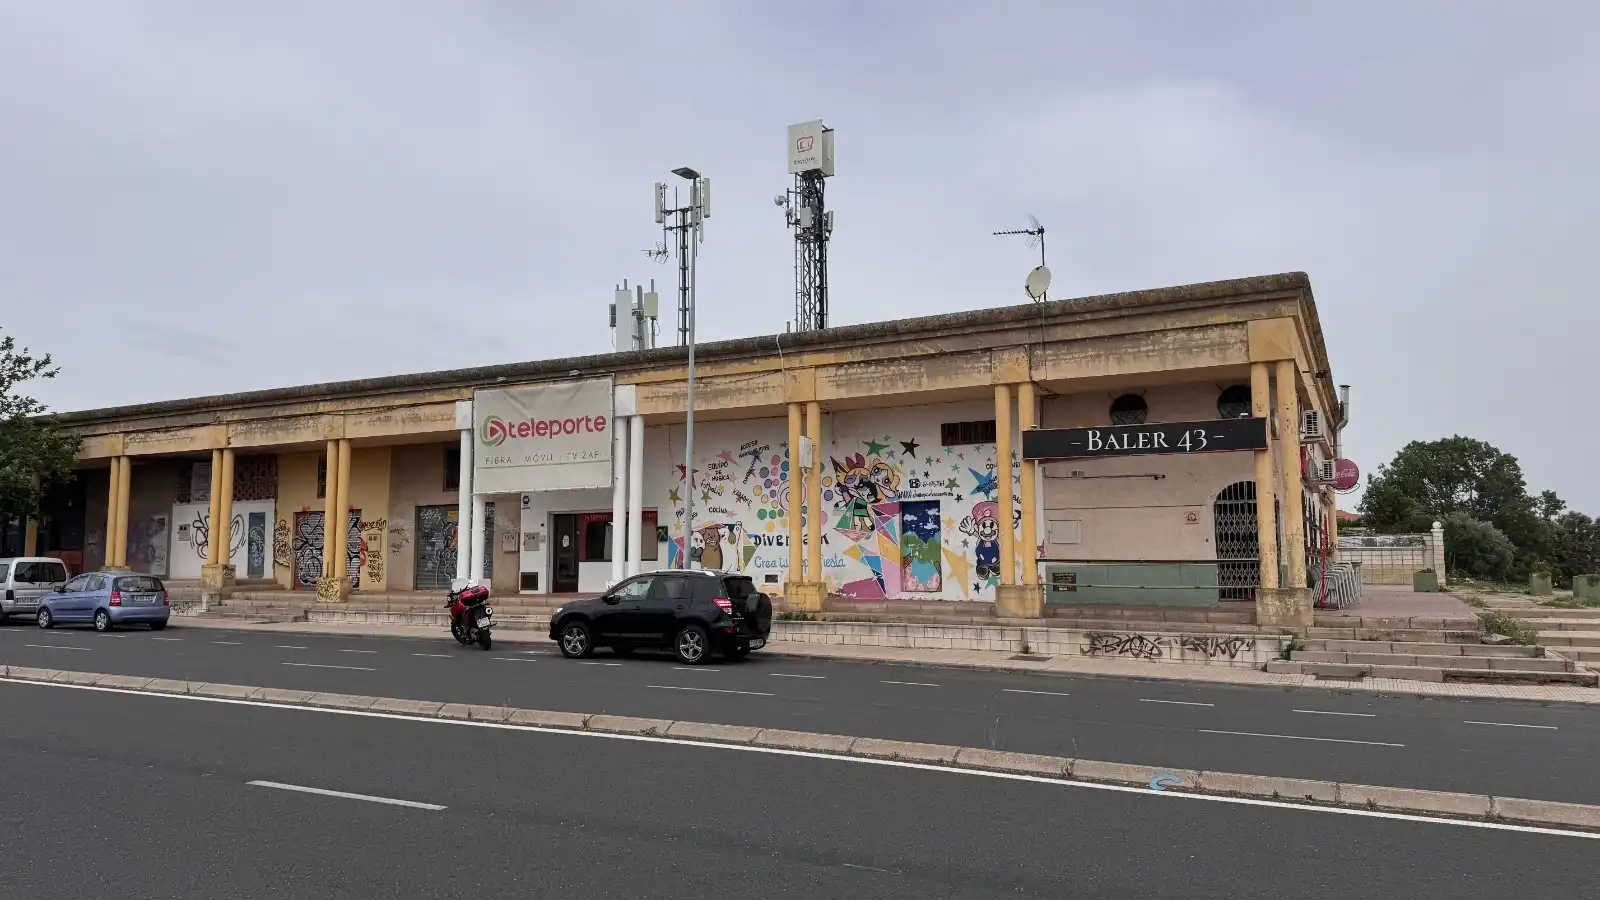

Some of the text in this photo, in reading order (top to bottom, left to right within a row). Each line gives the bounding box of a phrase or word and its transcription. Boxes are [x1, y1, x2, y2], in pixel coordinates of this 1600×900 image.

[508, 415, 606, 439] teleporte
[1177, 429, 1208, 452] 43
[567, 452, 577, 460] TV
[754, 556, 777, 569] Crea
